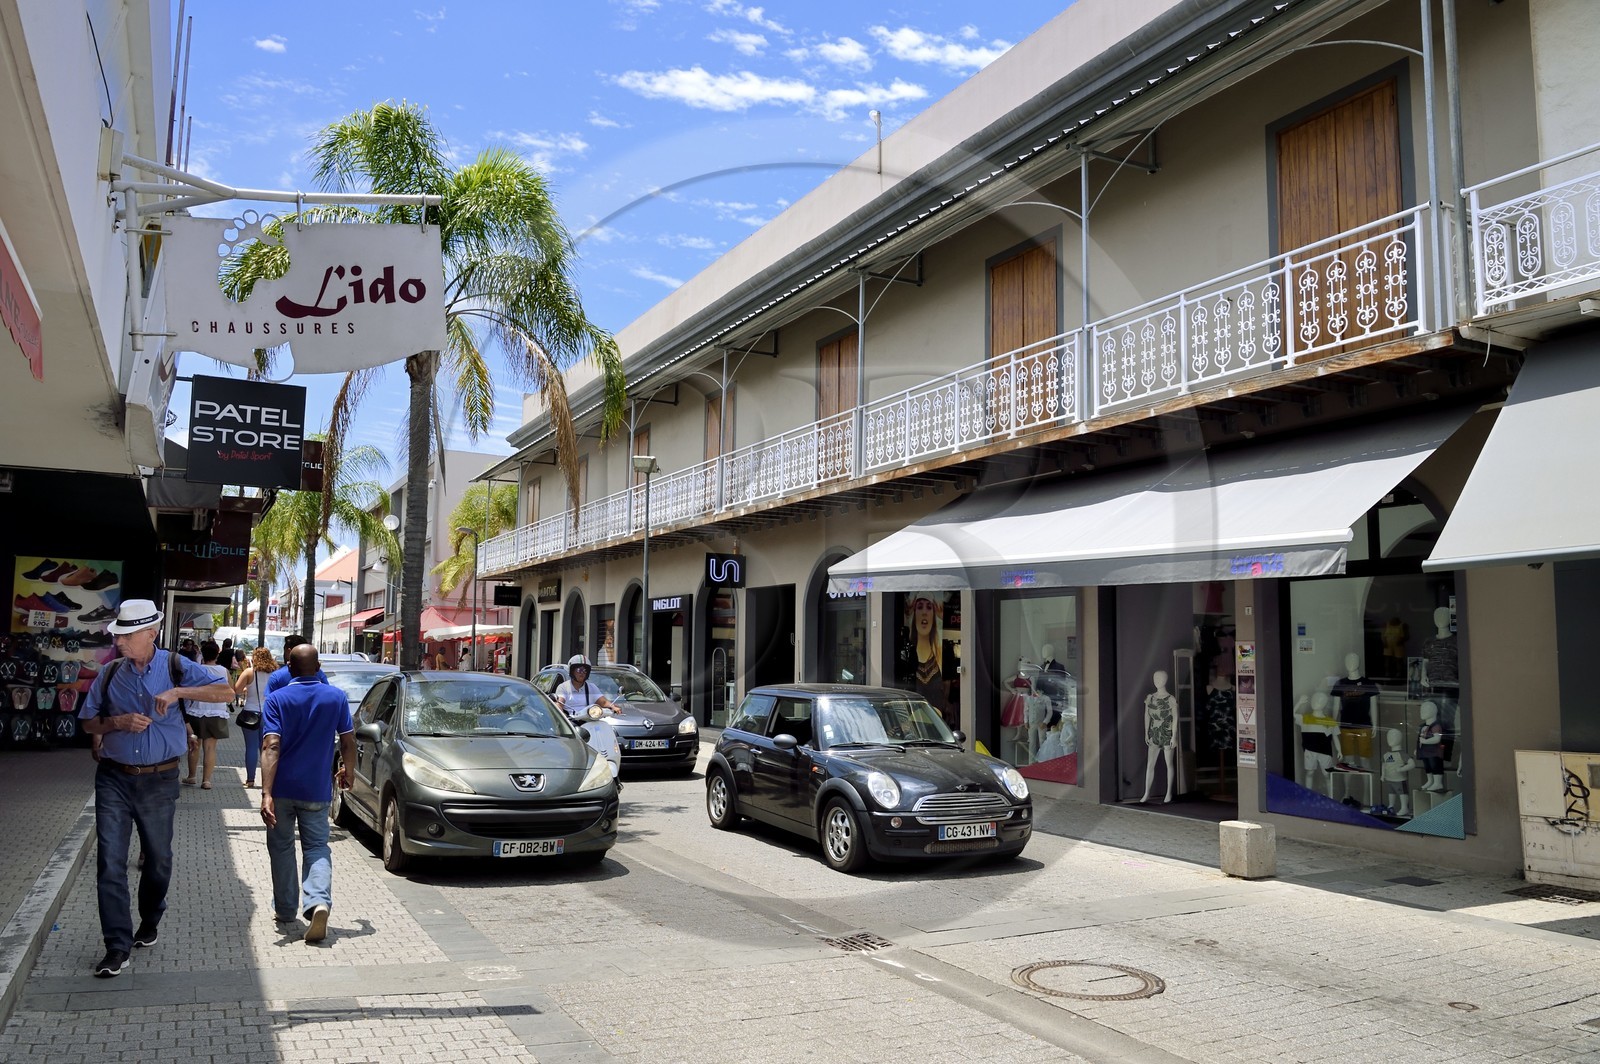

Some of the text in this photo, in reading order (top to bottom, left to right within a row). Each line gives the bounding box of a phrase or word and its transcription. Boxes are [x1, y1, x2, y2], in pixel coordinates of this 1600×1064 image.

[191, 320, 355, 335] CHAUSSURES
[194, 399, 301, 428] PATEL
[192, 425, 300, 451] STORE
[214, 546, 247, 557] FOLIE
[653, 597, 682, 611] INGLOT
[946, 824, 991, 839] CG-431-NV
[502, 841, 556, 854] CF-082-BW
